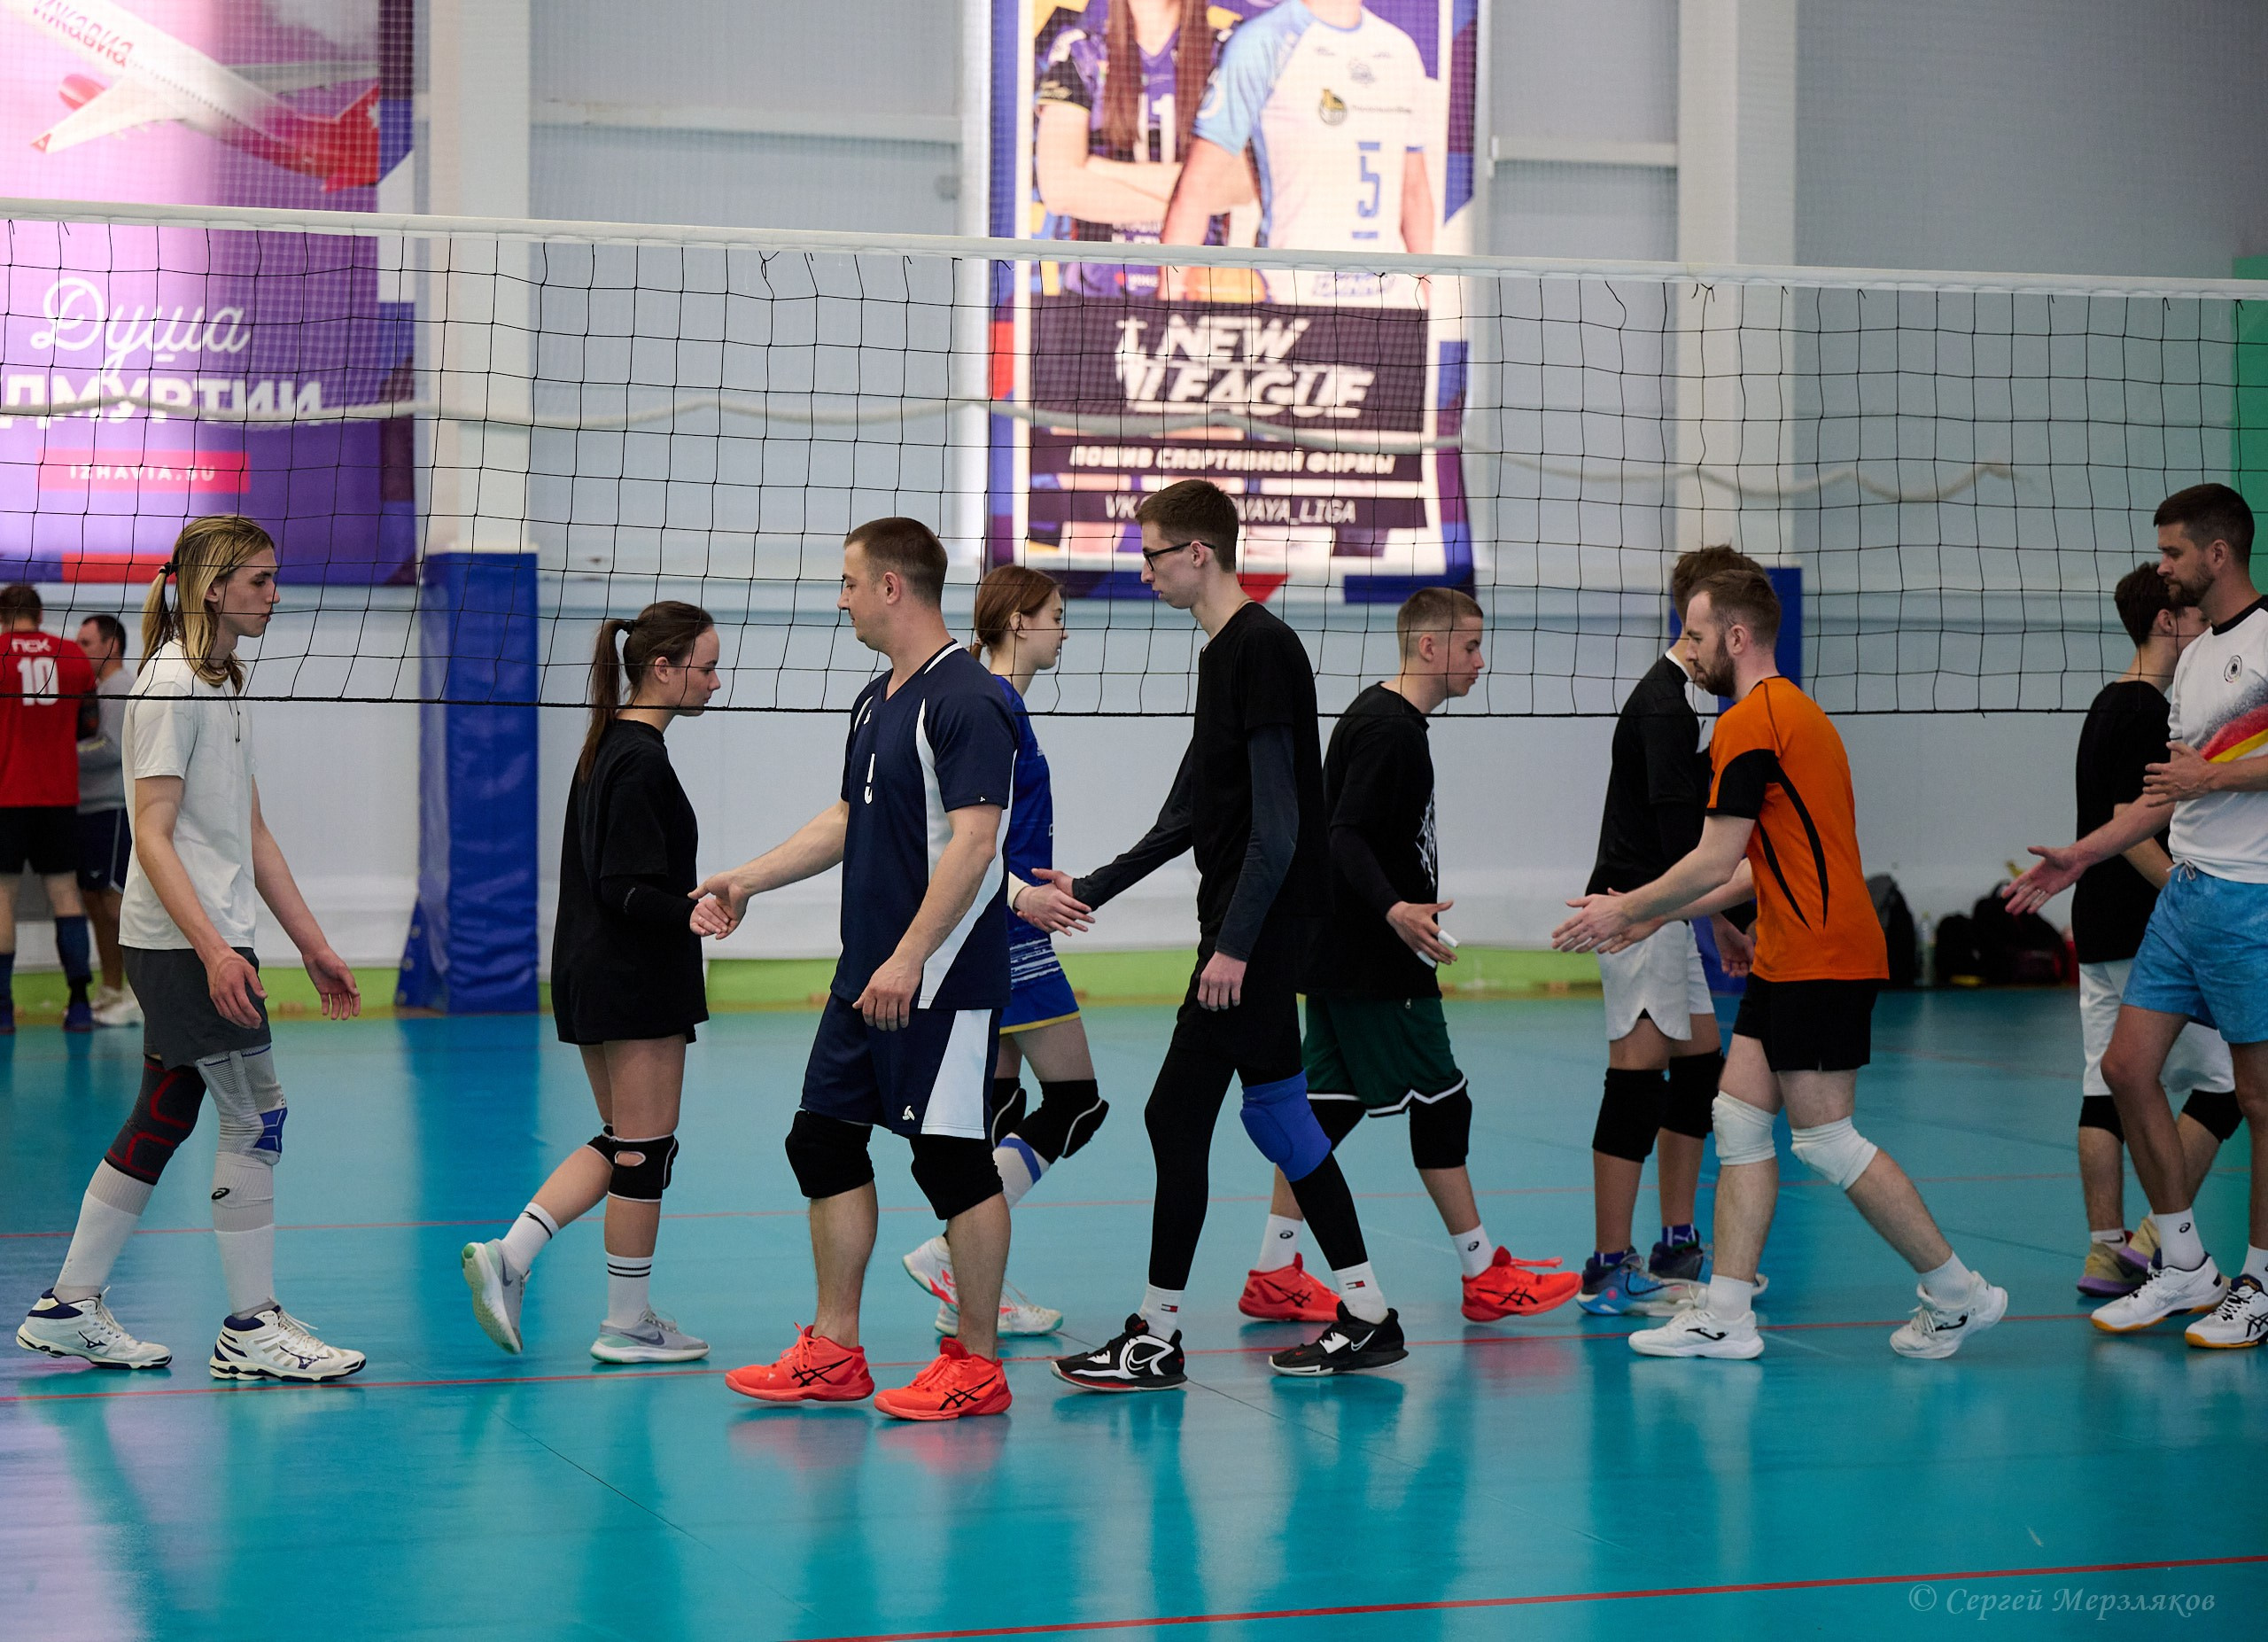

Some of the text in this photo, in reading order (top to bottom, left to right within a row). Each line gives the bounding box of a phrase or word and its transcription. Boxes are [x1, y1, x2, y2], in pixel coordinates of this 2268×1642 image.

[1357, 155, 1380, 217] 5
[30, 276, 250, 378] Душа
[1154, 314, 1311, 363] NEW
[0, 374, 323, 430] ДМУРТИИ
[1128, 363, 1376, 418] LEAGUE
[69, 463, 215, 481] IZHAVIA.SU
[1068, 446, 1395, 474] ПОШИВ СПОРТИВНОЙ ФОРМЫ
[17, 657, 59, 706] 10
